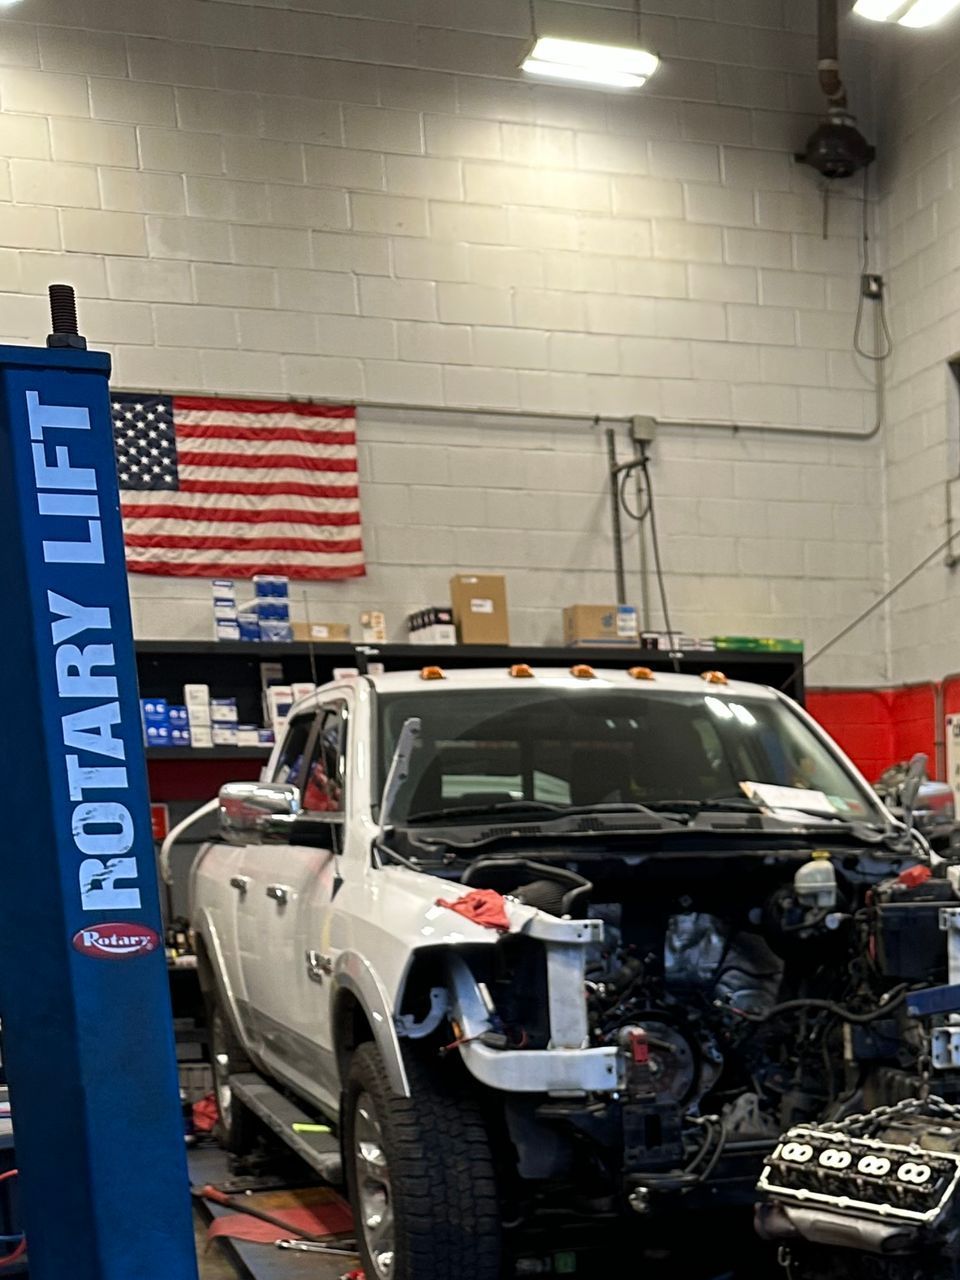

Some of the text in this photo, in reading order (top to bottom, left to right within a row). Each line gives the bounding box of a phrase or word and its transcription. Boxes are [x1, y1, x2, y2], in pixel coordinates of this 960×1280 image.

[26, 390, 142, 910] ROTARY LIFT
[81, 930, 151, 951] Rotary
